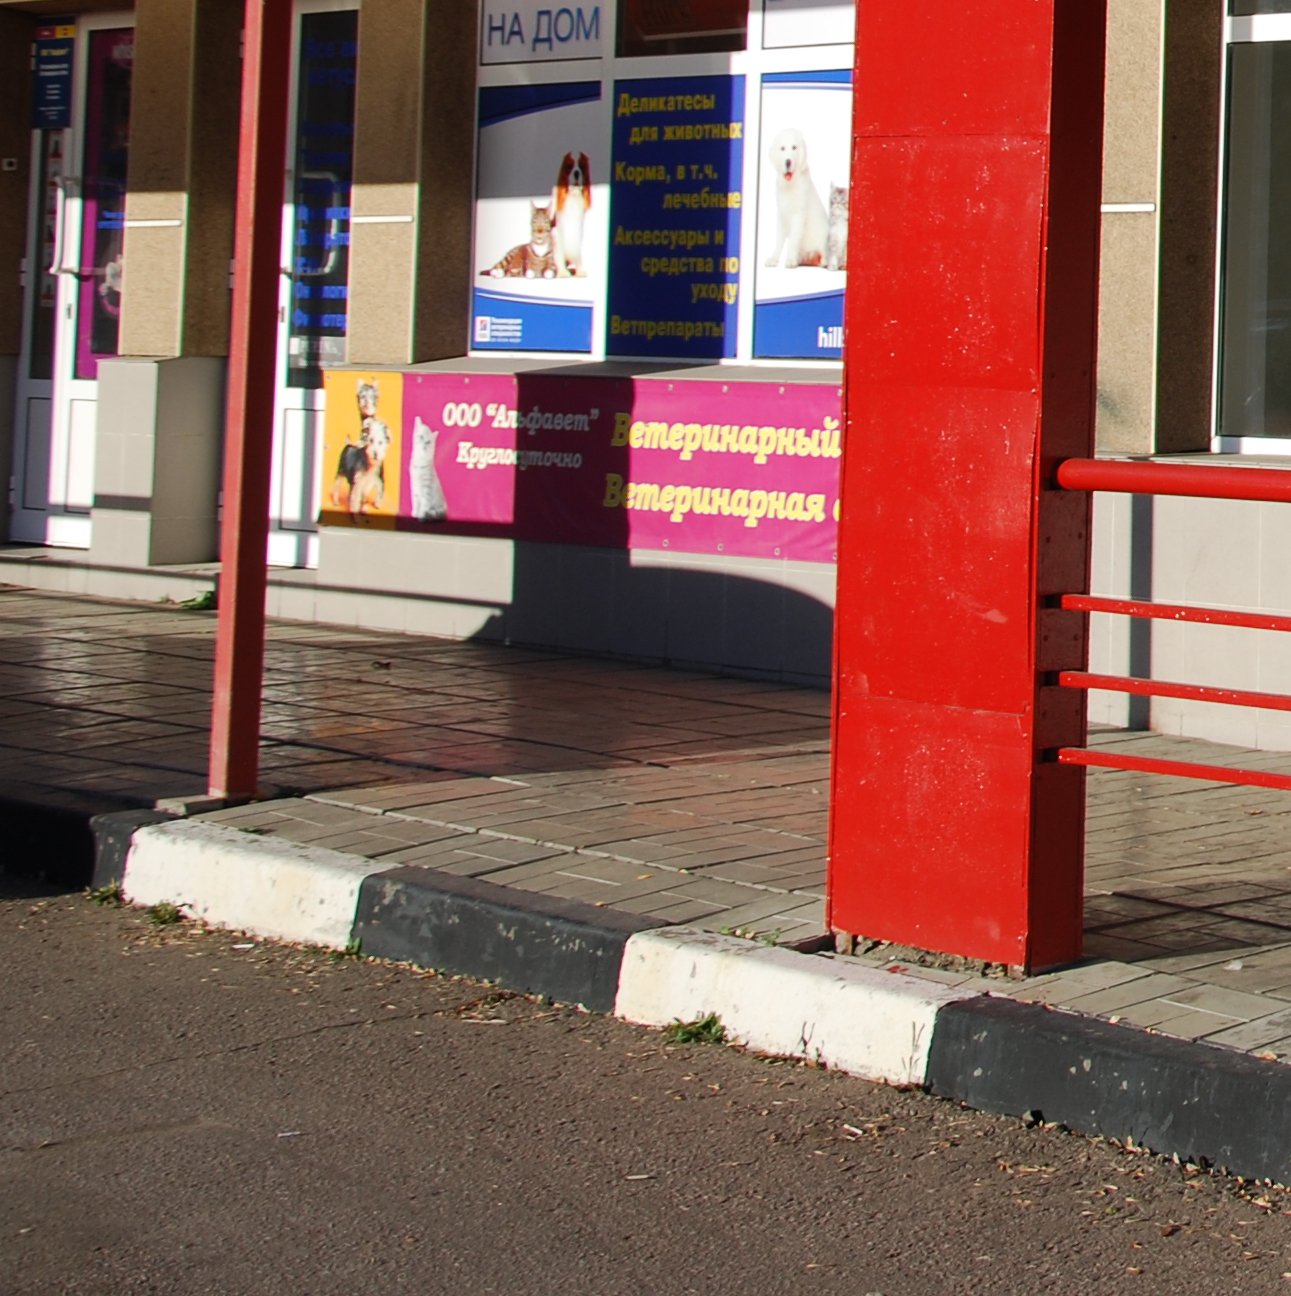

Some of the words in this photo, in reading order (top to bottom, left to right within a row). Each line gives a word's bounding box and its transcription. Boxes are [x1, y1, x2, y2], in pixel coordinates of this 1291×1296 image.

[487, 11, 525, 47] НА
[531, 6, 600, 52] ДОМ
[617, 92, 715, 117] Деликатесы
[629, 126, 658, 145] для
[663, 121, 743, 141] животных
[614, 161, 671, 185] Корма,
[676, 165, 686, 180] в
[690, 164, 718, 180] т.ч.
[662, 187, 742, 209] лечебные
[613, 225, 710, 249] Аксессуары
[714, 229, 724, 245] и
[640, 255, 713, 276] средства
[719, 254, 739, 274] по
[690, 282, 739, 305] уходу
[610, 314, 726, 340] Ветпрепараты
[817, 325, 844, 349] hill
[442, 402, 482, 428] ООО
[610, 411, 842, 465] Ветеринарный
[455, 440, 583, 470] Круглосуточно
[603, 472, 826, 528] Ветеринарная
